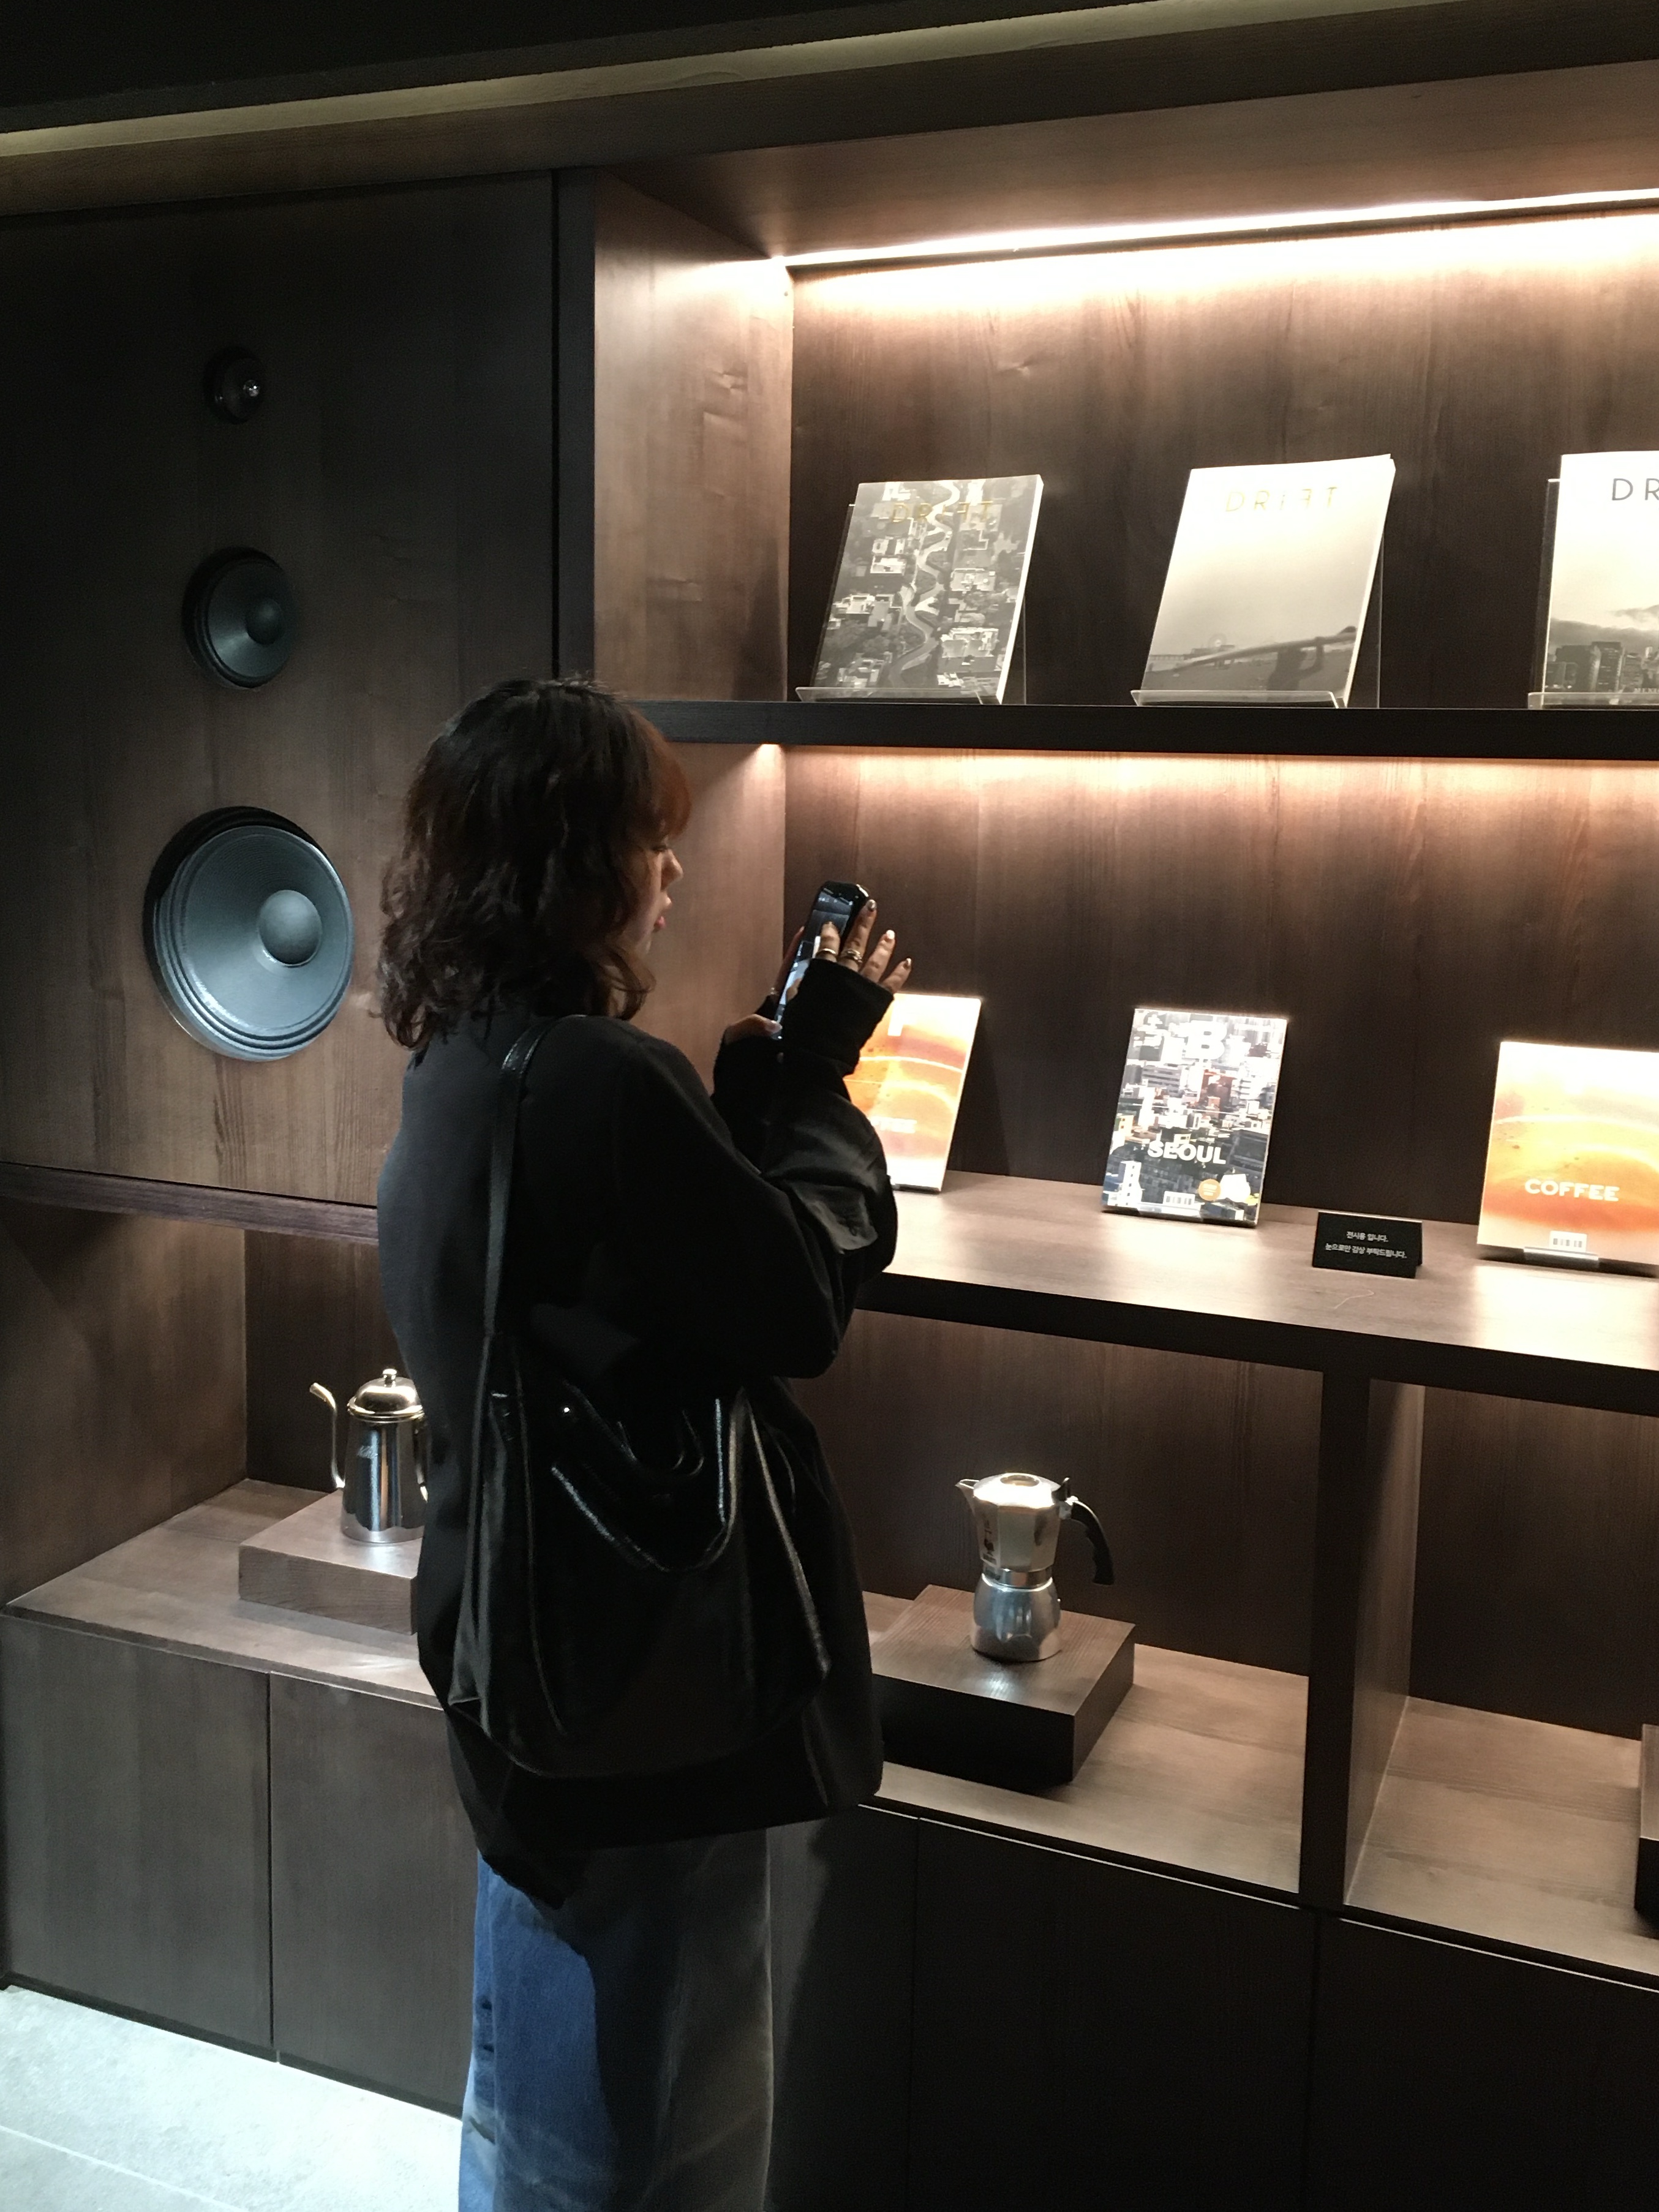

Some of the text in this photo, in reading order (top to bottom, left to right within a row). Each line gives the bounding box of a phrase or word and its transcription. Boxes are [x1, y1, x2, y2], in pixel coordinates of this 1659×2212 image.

[1185, 1020, 1228, 1060] B
[1147, 1140, 1226, 1165] SEOUL
[1525, 1178, 1620, 1202] COFFEE
[1346, 1231, 1366, 1240] 전시용
[1325, 1243, 1352, 1253] 눈으로만
[1352, 1245, 1366, 1254] 감상
